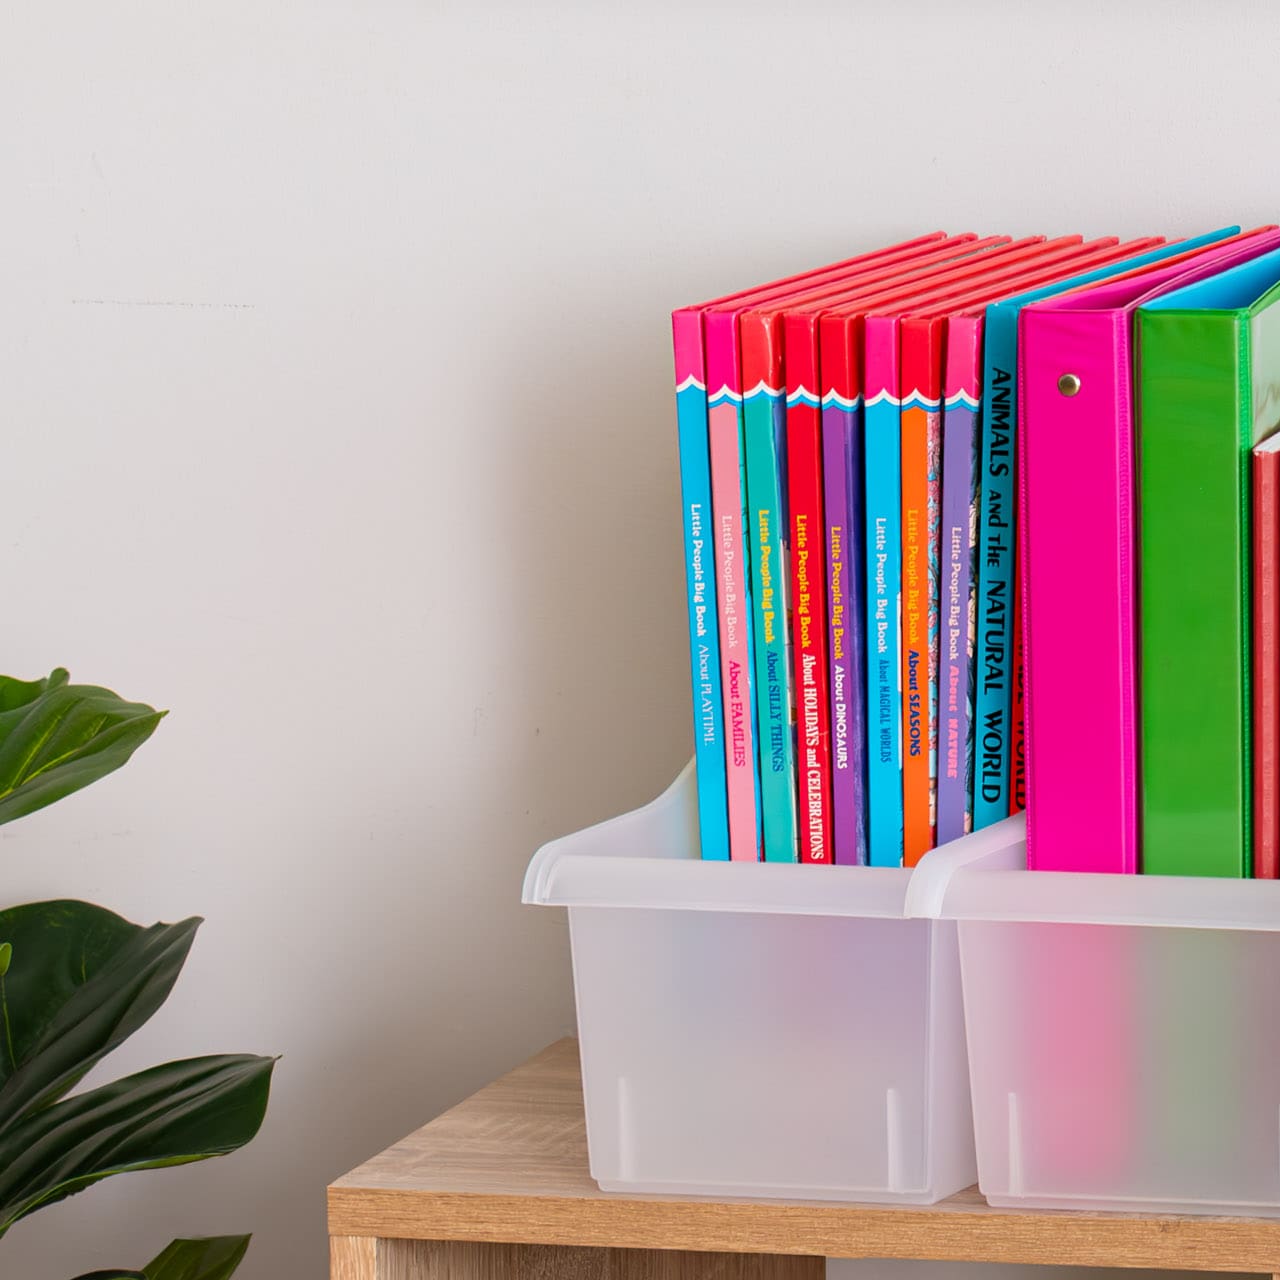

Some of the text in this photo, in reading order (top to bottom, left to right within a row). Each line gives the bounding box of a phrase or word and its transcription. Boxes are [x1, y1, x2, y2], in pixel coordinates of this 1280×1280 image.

[691, 504, 707, 636] Little People Big Book
[950, 527, 961, 660] Little People Big Book
[982, 368, 1012, 803] ANIMALS NATURAL WORLD
[832, 527, 847, 769] Little People Big Book About DINOSAURS
[876, 518, 892, 763] Little People Big Book MAGICAL WORLDS
[909, 650, 920, 756] About SEASONS
[729, 661, 746, 766] About FAMILIES
[767, 651, 784, 772] About SILLY THINGS
[801, 617, 824, 859] Book About HOLIDAYS and CELEBRATIONS
